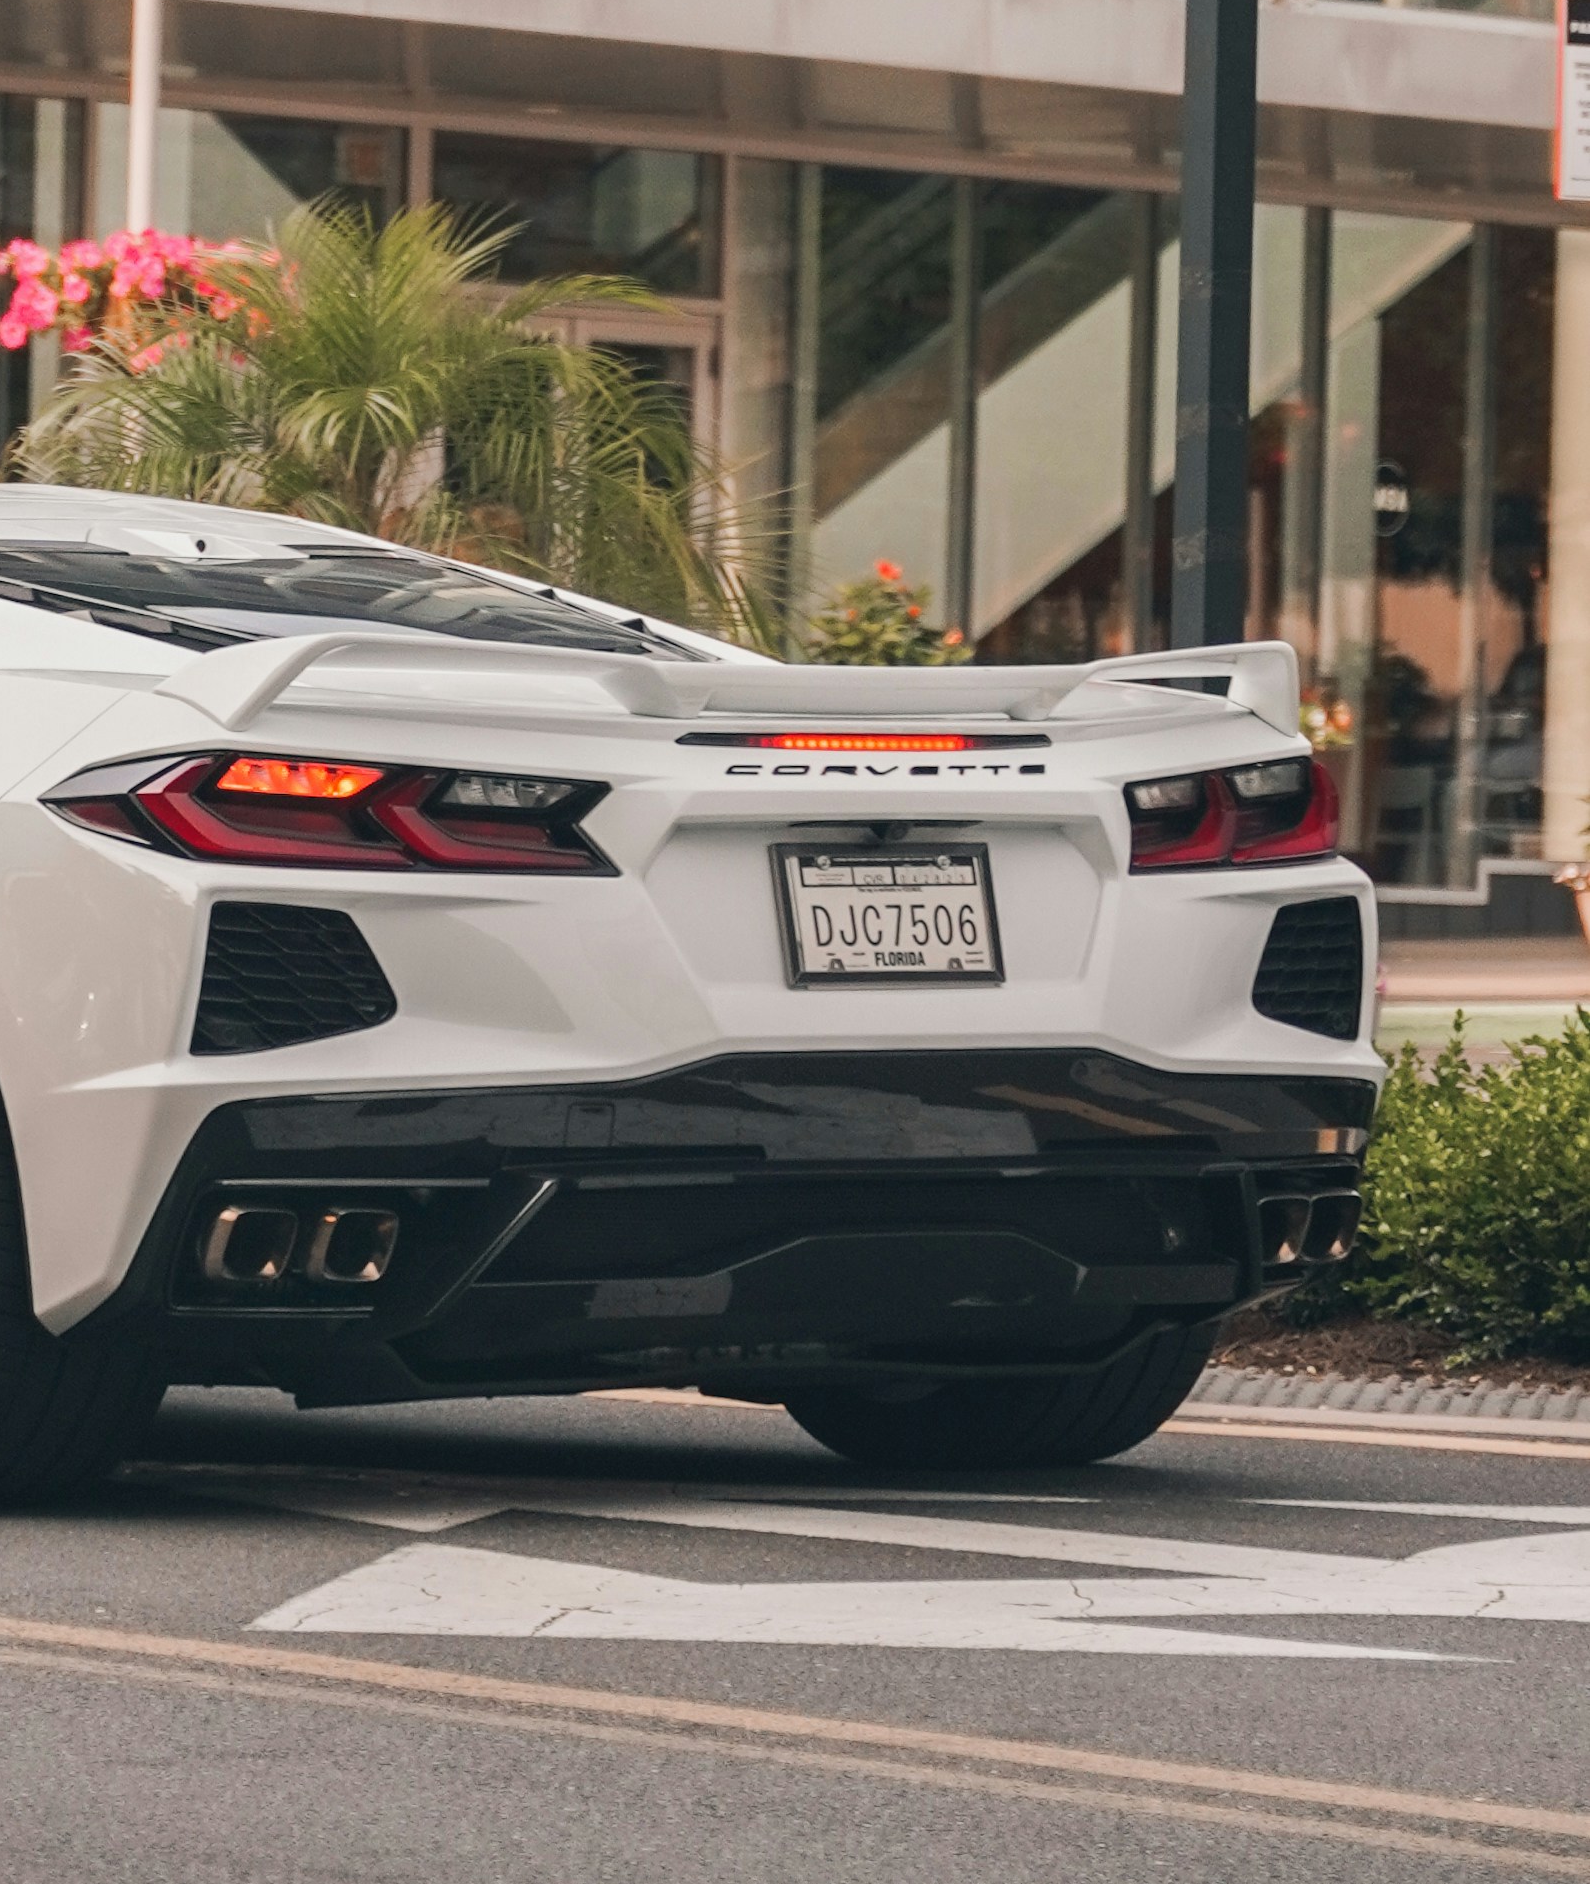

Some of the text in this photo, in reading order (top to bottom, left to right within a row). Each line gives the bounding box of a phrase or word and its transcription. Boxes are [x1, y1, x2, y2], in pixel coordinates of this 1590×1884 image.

[725, 764, 1046, 776] CORVETTE
[811, 904, 977, 947] DJC7506
[874, 951, 926, 967] FLORIDA
